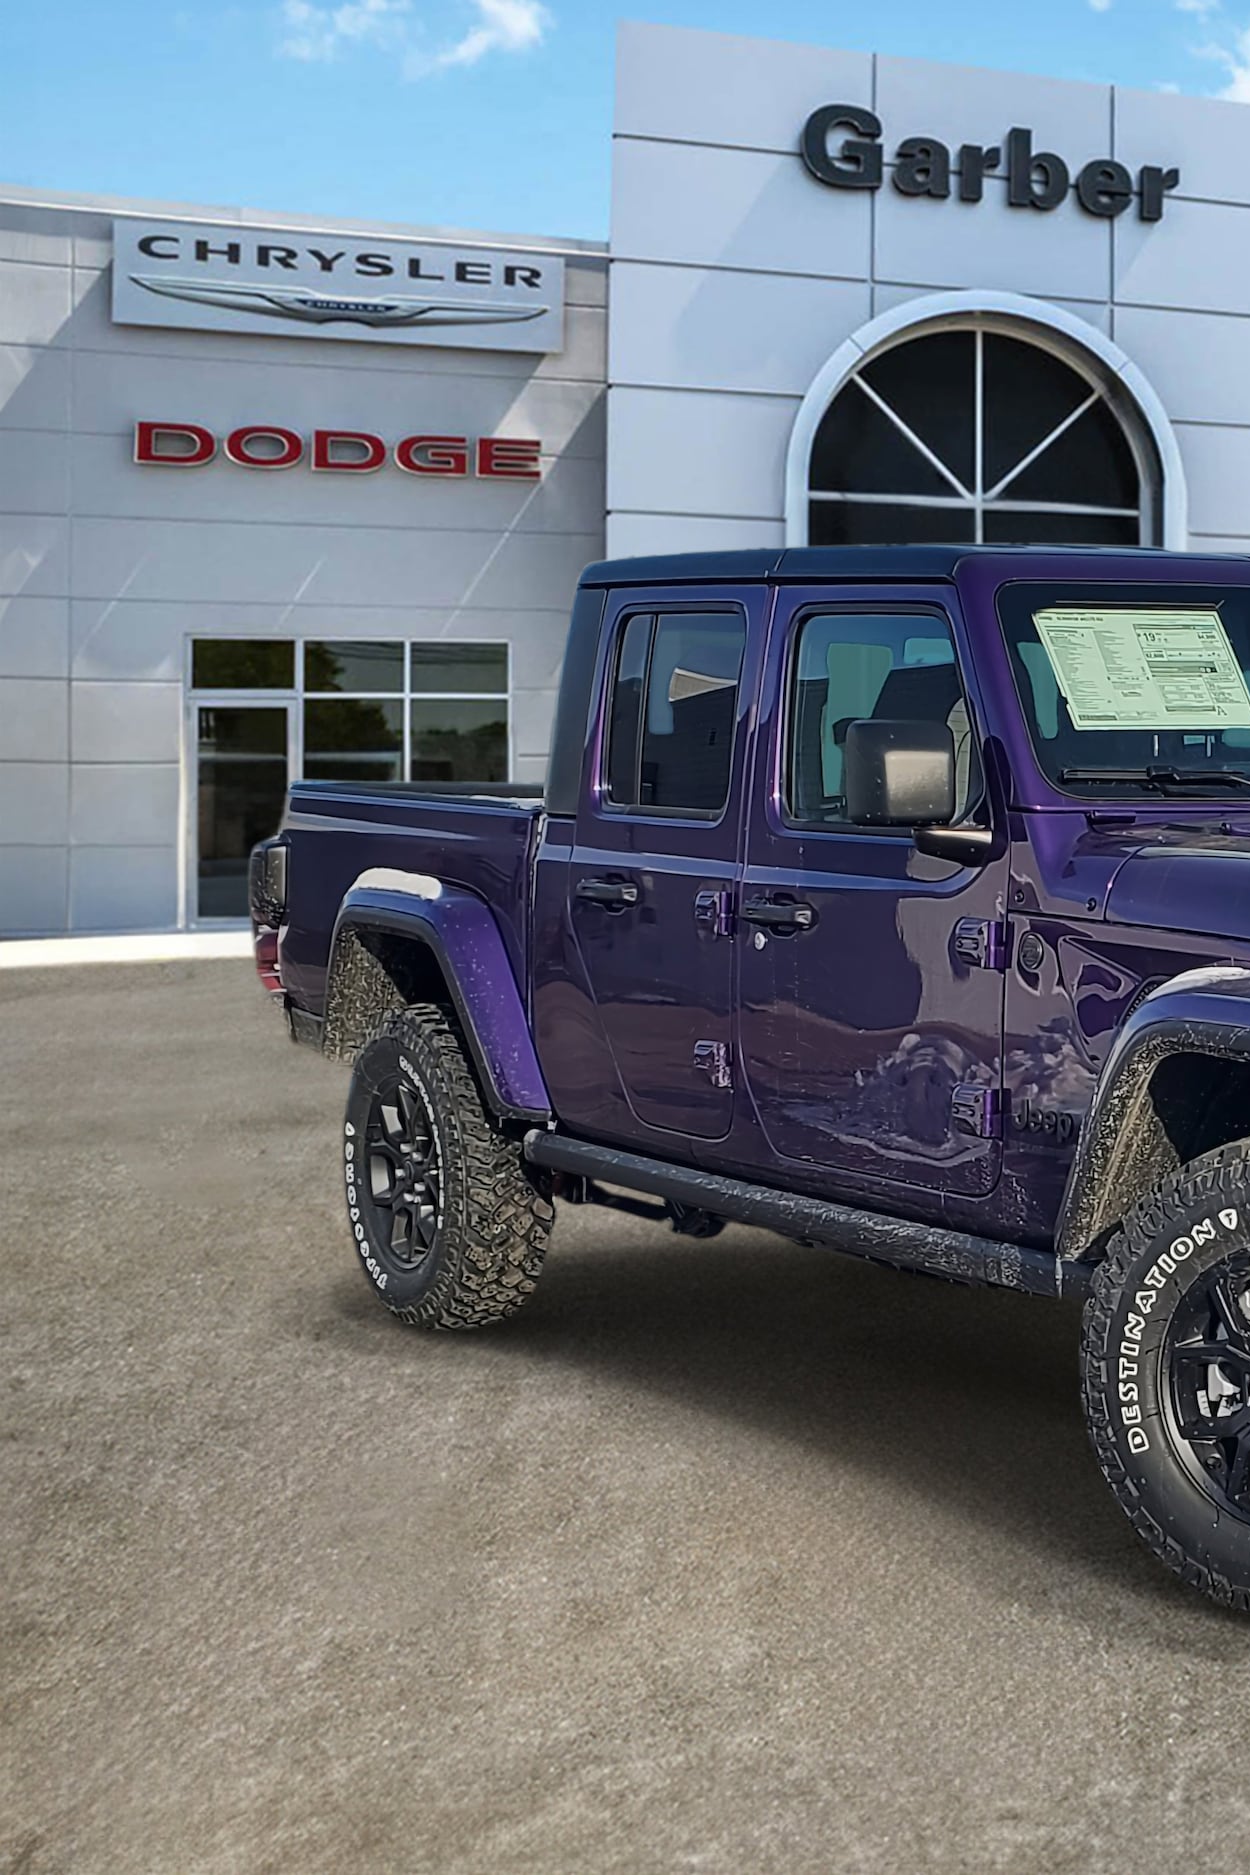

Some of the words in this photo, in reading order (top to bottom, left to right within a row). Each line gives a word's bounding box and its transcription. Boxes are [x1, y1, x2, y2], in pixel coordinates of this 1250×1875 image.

[801, 104, 1179, 222] Garber
[138, 235, 542, 287] CHRYSLER
[134, 421, 542, 479] DODGE
[1013, 1099, 1074, 1142] Jeep
[1118, 1217, 1217, 1453] DESTINATION
